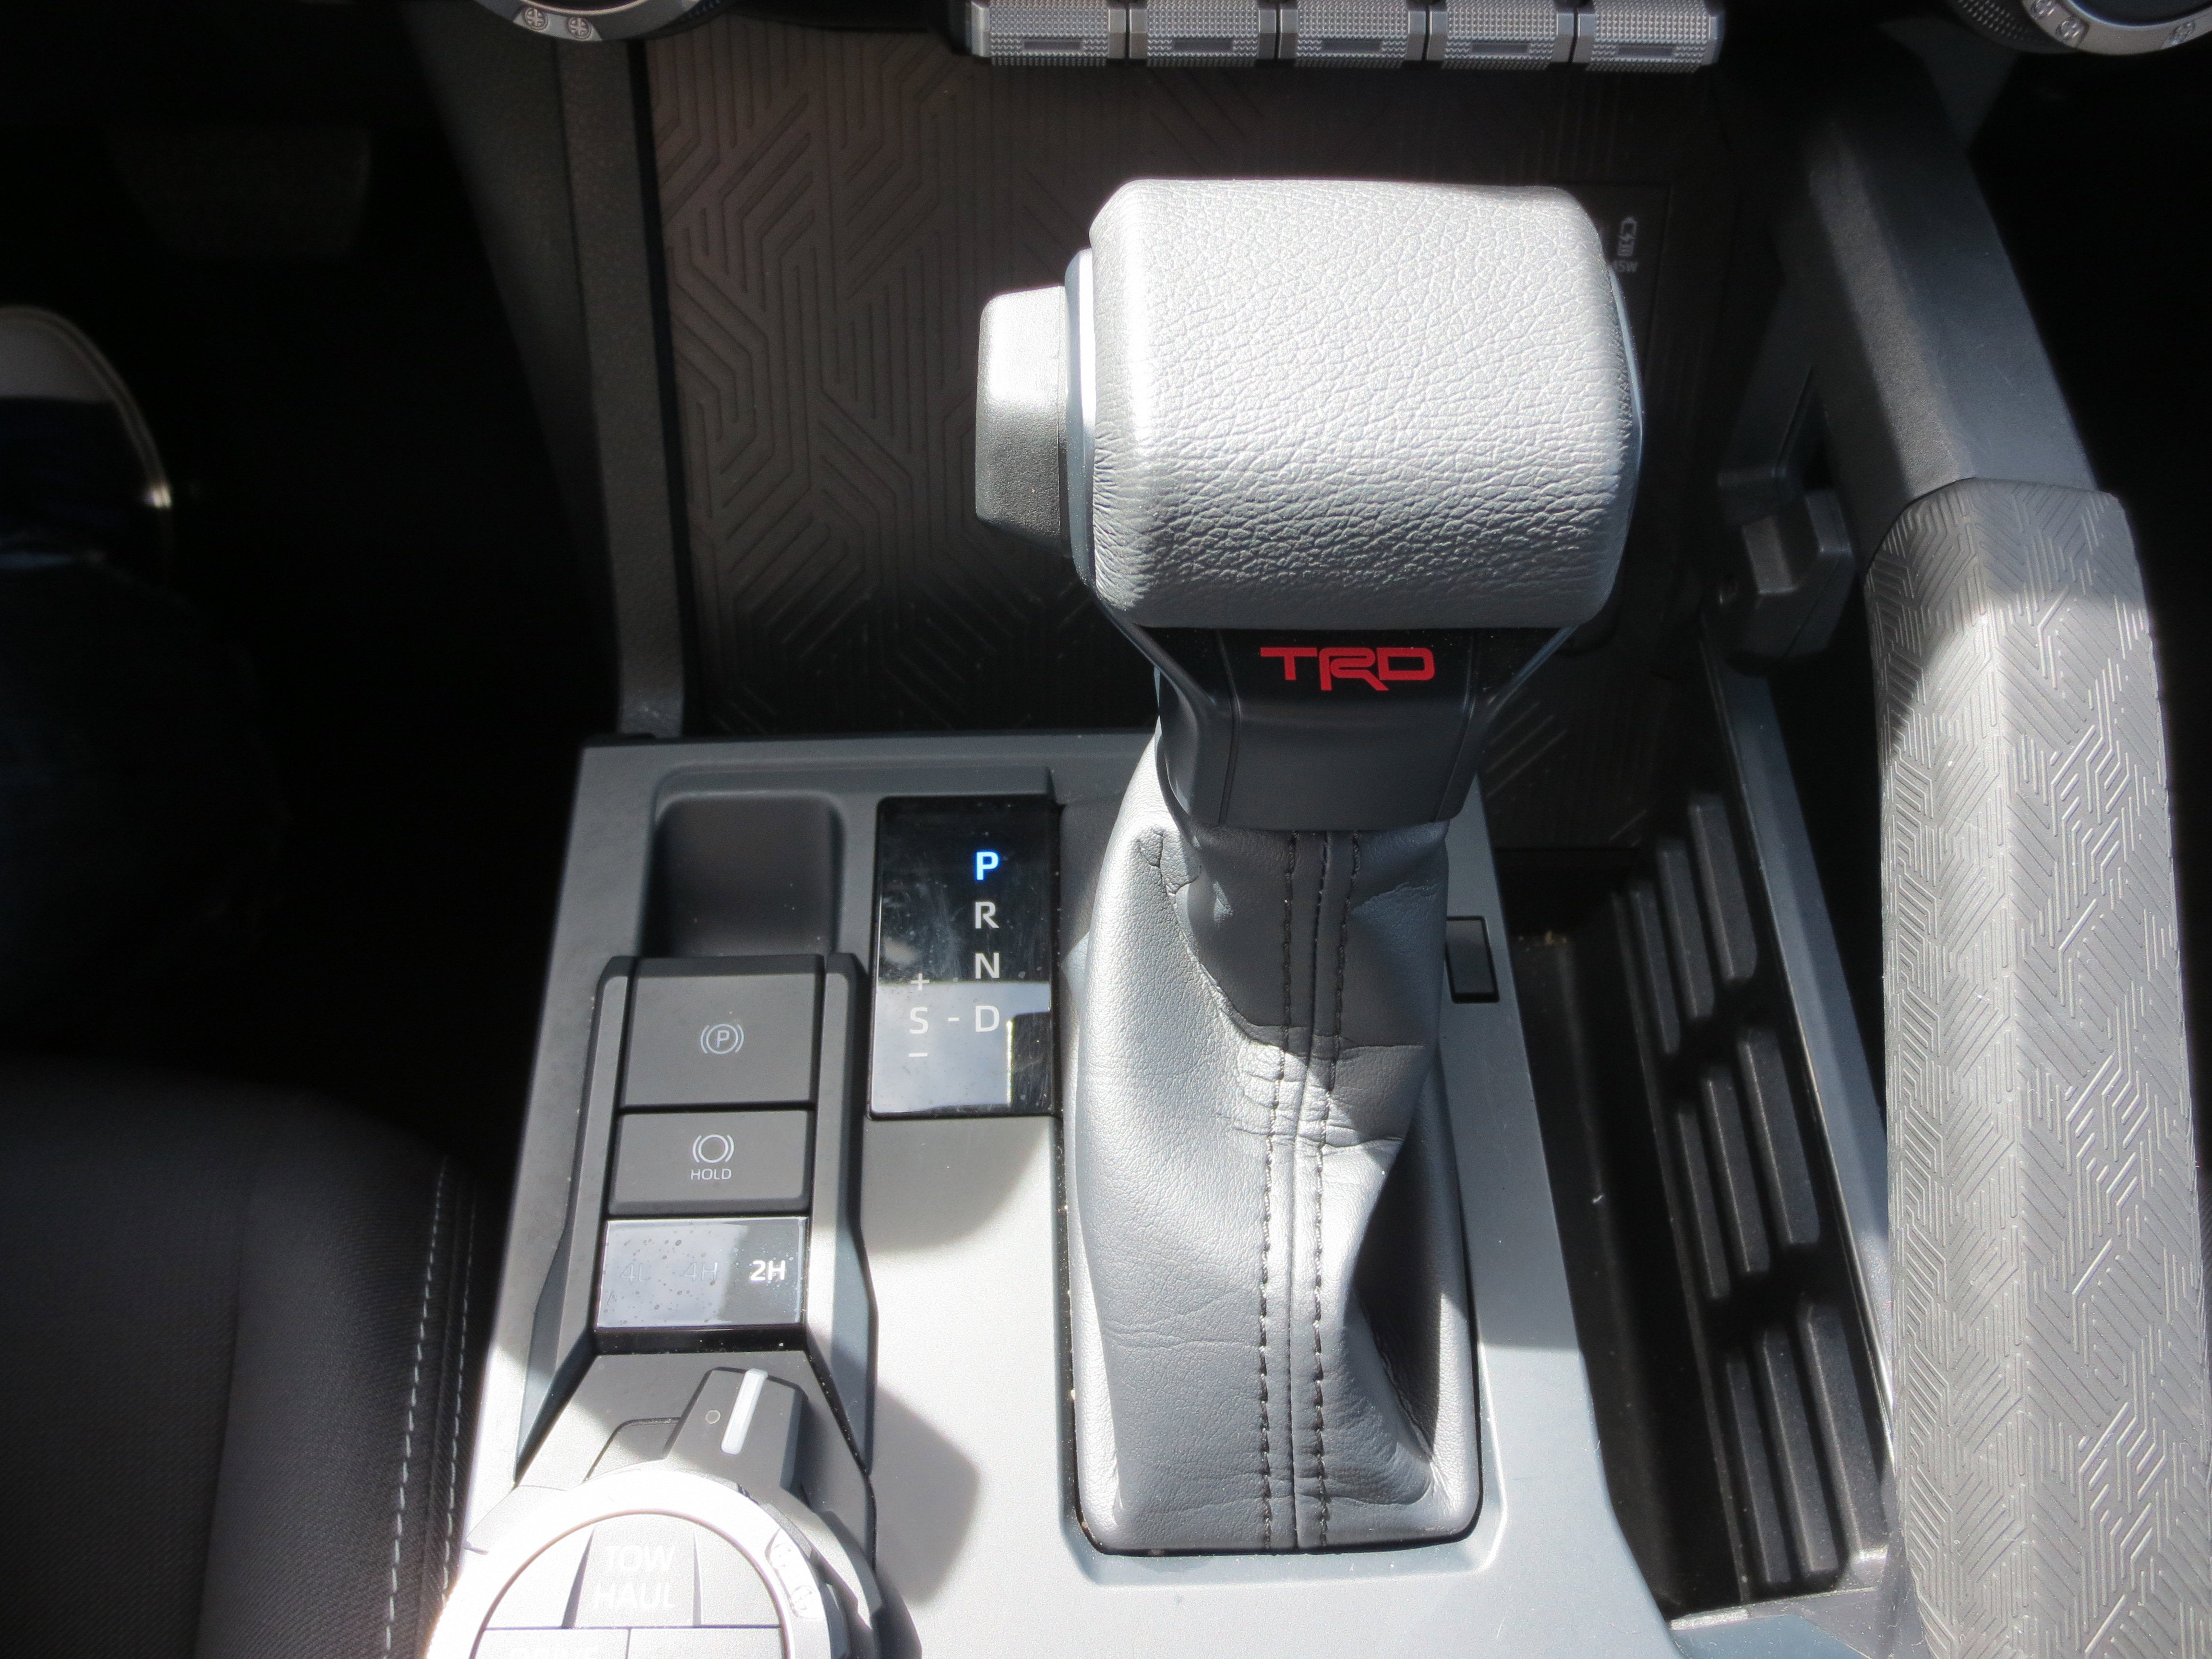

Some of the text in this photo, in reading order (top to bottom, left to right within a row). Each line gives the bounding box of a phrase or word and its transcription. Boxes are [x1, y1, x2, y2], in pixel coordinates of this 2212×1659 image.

[1260, 647, 1435, 691] TRD
[975, 851, 999, 880] P
[975, 902, 999, 929] R
[975, 952, 1000, 979] N
[910, 1007, 929, 1034] S
[975, 1005, 1000, 1032] D
[690, 1168, 732, 1180] HOLD
[683, 1262, 719, 1282] 4H
[750, 1260, 787, 1283] 2H
[605, 1545, 675, 1572] TOW
[593, 1582, 675, 1610] HAUL
